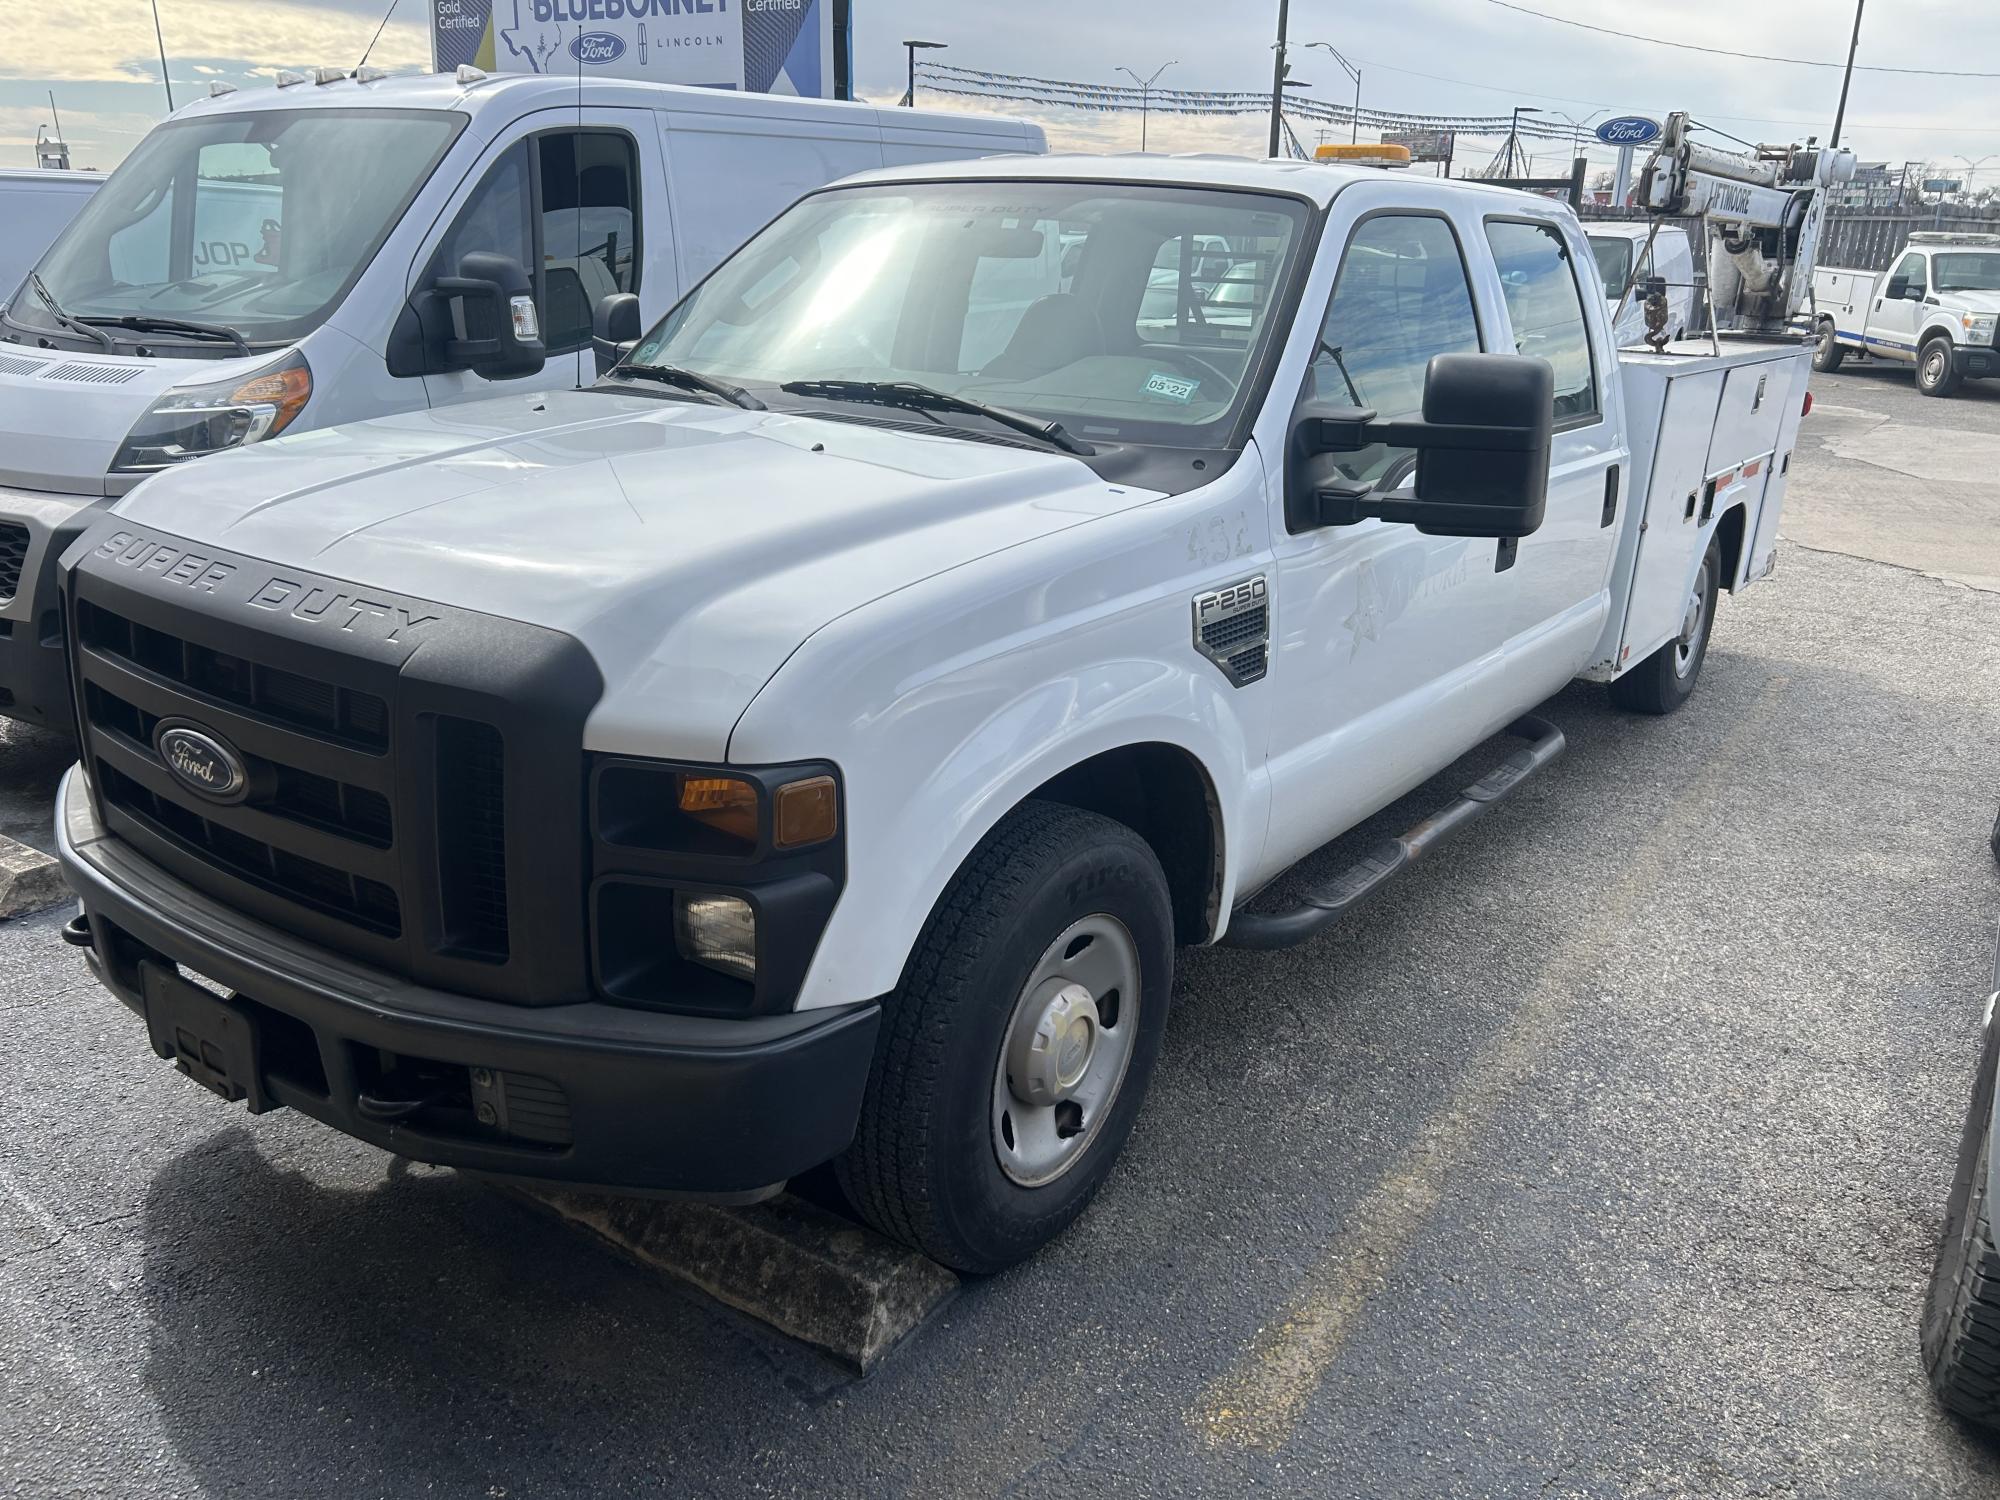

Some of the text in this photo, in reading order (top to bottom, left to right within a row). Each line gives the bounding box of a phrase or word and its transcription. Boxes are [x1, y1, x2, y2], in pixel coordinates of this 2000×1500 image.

[438, 1, 460, 13] Gold
[747, 0, 801, 11] Certified
[439, 14, 480, 28] Certified
[580, 37, 614, 58] Ford
[657, 35, 723, 48] LINCOLN
[1607, 121, 1647, 139] Ford
[94, 531, 440, 643] SUPER DUTY
[1200, 579, 1266, 617] F-250
[171, 739, 215, 783] Ford
